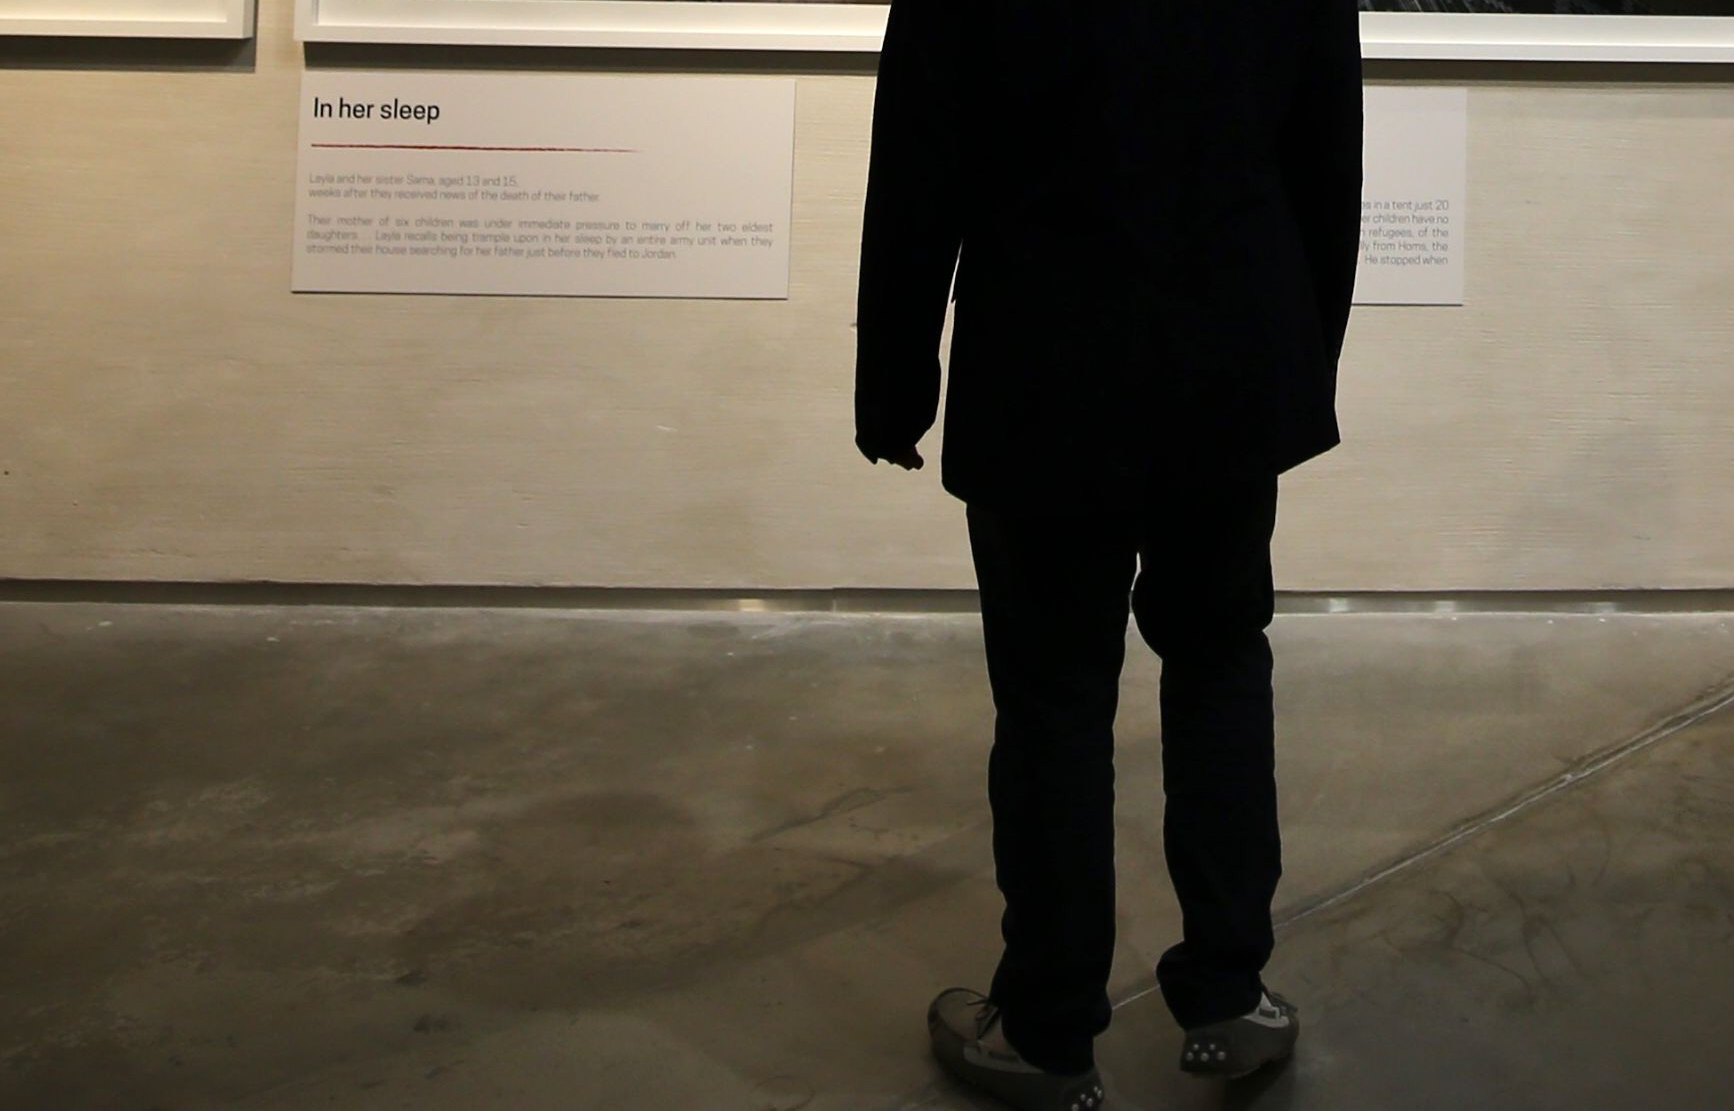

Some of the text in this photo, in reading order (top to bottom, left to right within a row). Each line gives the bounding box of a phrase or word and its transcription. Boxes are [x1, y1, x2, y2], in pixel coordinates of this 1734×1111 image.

[314, 97, 440, 125] In her sleep
[309, 172, 335, 185] Layla
[336, 173, 355, 183] and
[357, 173, 372, 184] her
[375, 174, 403, 184] sister
[438, 175, 464, 188] aged
[466, 175, 480, 186] 13
[482, 175, 500, 186] and
[308, 186, 341, 197] weeks
[343, 187, 367, 197] after
[370, 187, 392, 200] they
[394, 188, 438, 198] received
[440, 191, 466, 199] news
[469, 189, 479, 199] of
[481, 189, 498, 199] the
[500, 189, 529, 200] death
[531, 190, 543, 200] of
[1392, 199, 1449, 212] tent just 20
[308, 214, 773, 233] Their mother of six children was under immediate pressure to marry off her two eldest
[1372, 212, 1410, 222] children
[1412, 213, 1435, 223] have
[1418, 226, 1427, 236] of
[1432, 226, 1448, 236] the
[375, 230, 401, 243] Layla
[404, 230, 437, 240] recalls
[441, 230, 468, 244] being
[513, 234, 538, 245] upon
[554, 232, 571, 243] her
[575, 232, 602, 246] sleep
[605, 233, 617, 246] by
[637, 233, 666, 244] entire
[670, 236, 693, 247] army
[698, 234, 716, 245] unit
[720, 235, 748, 245] when
[751, 235, 773, 248] they
[1373, 240, 1396, 250] from
[1432, 240, 1448, 250] the
[306, 242, 349, 253] stormed
[375, 243, 407, 254] house
[409, 244, 457, 257] searching
[459, 244, 474, 255] for
[475, 245, 492, 255] her
[526, 246, 545, 259] just
[548, 246, 581, 257] before
[583, 246, 605, 260] they
[629, 247, 640, 258] to
[1365, 253, 1448, 266] He stopped when
